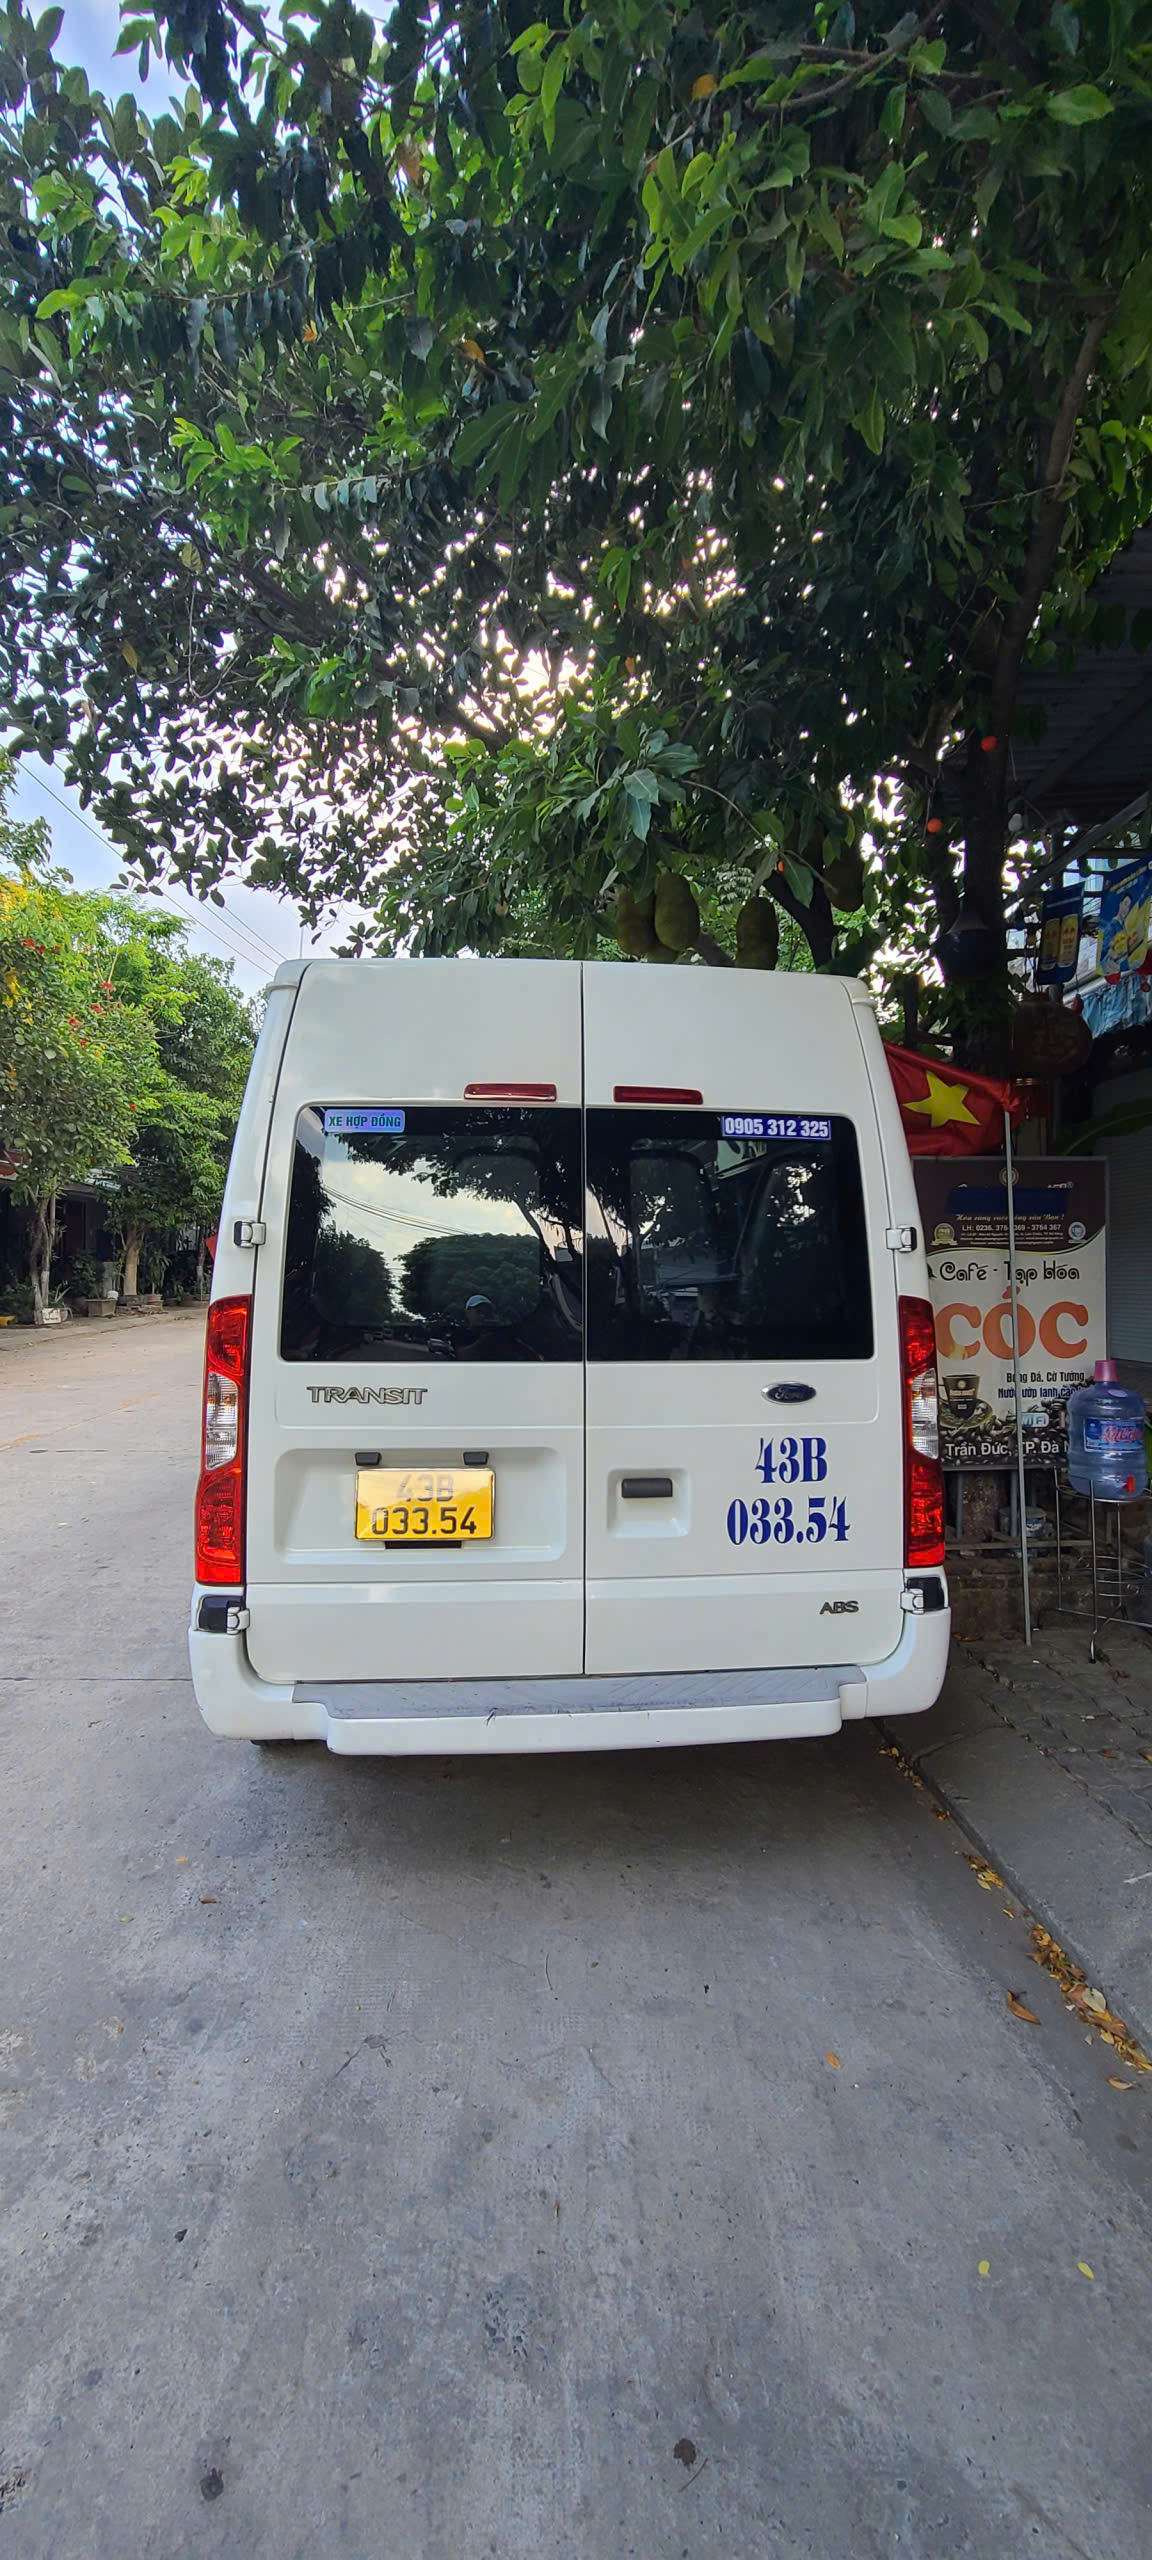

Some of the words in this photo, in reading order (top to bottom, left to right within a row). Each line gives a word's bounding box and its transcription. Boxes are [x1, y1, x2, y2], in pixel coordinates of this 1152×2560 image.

[328, 1116, 342, 1127] XE
[346, 1115, 368, 1128] HỢP
[725, 1117, 764, 1135] 0905
[767, 1119, 797, 1136] 312
[800, 1121, 829, 1137] 325
[939, 1261, 988, 1281] Café
[306, 1386, 428, 1405] TRANSIT
[945, 1442, 976, 1456] Trần
[981, 1441, 1012, 1456] Đức,
[1041, 1440, 1060, 1454] Đà
[755, 1437, 828, 1484] 43B
[396, 1474, 456, 1502] 43B
[371, 1507, 477, 1535] 033.54
[726, 1495, 851, 1545] 033.54
[819, 1600, 859, 1615] ABS
